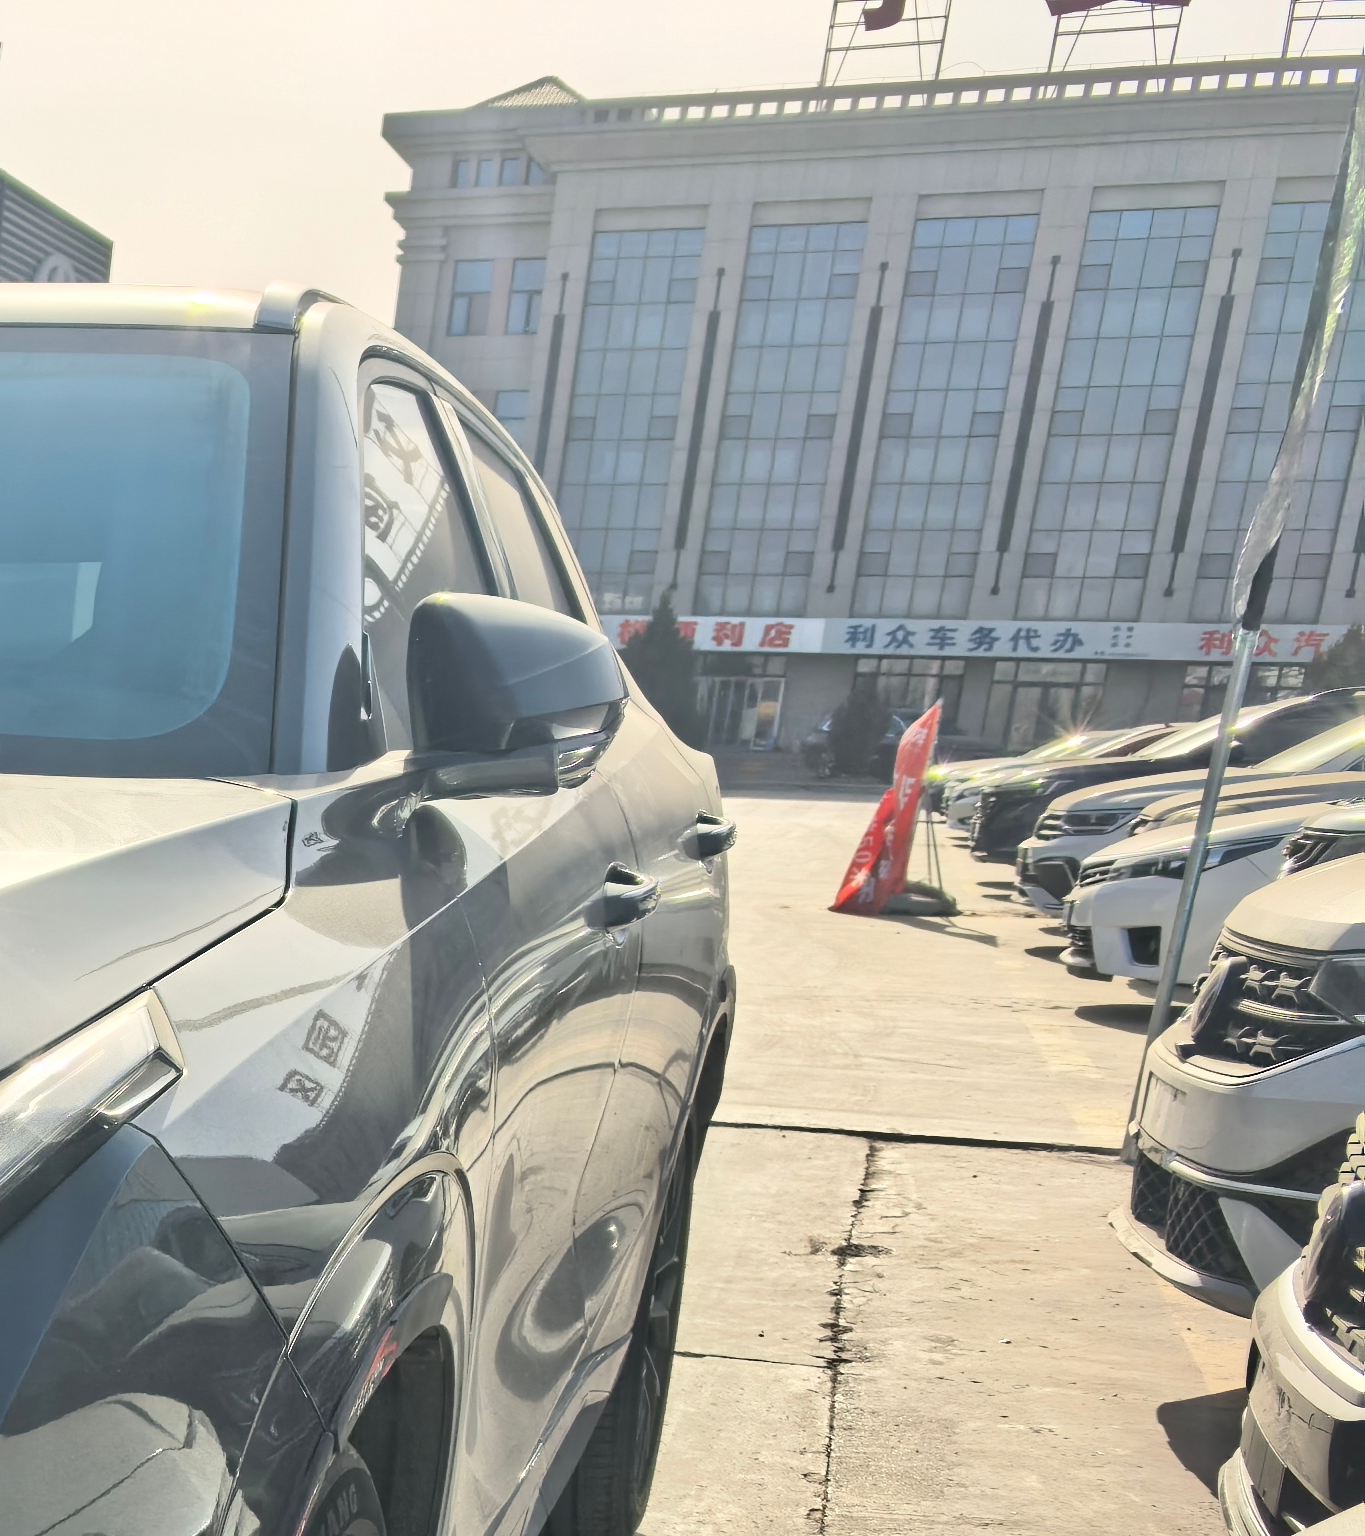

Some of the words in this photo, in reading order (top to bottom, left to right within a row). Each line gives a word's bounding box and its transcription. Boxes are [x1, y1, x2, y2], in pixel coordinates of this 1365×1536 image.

[844, 623, 1085, 653] 利众车务代办
